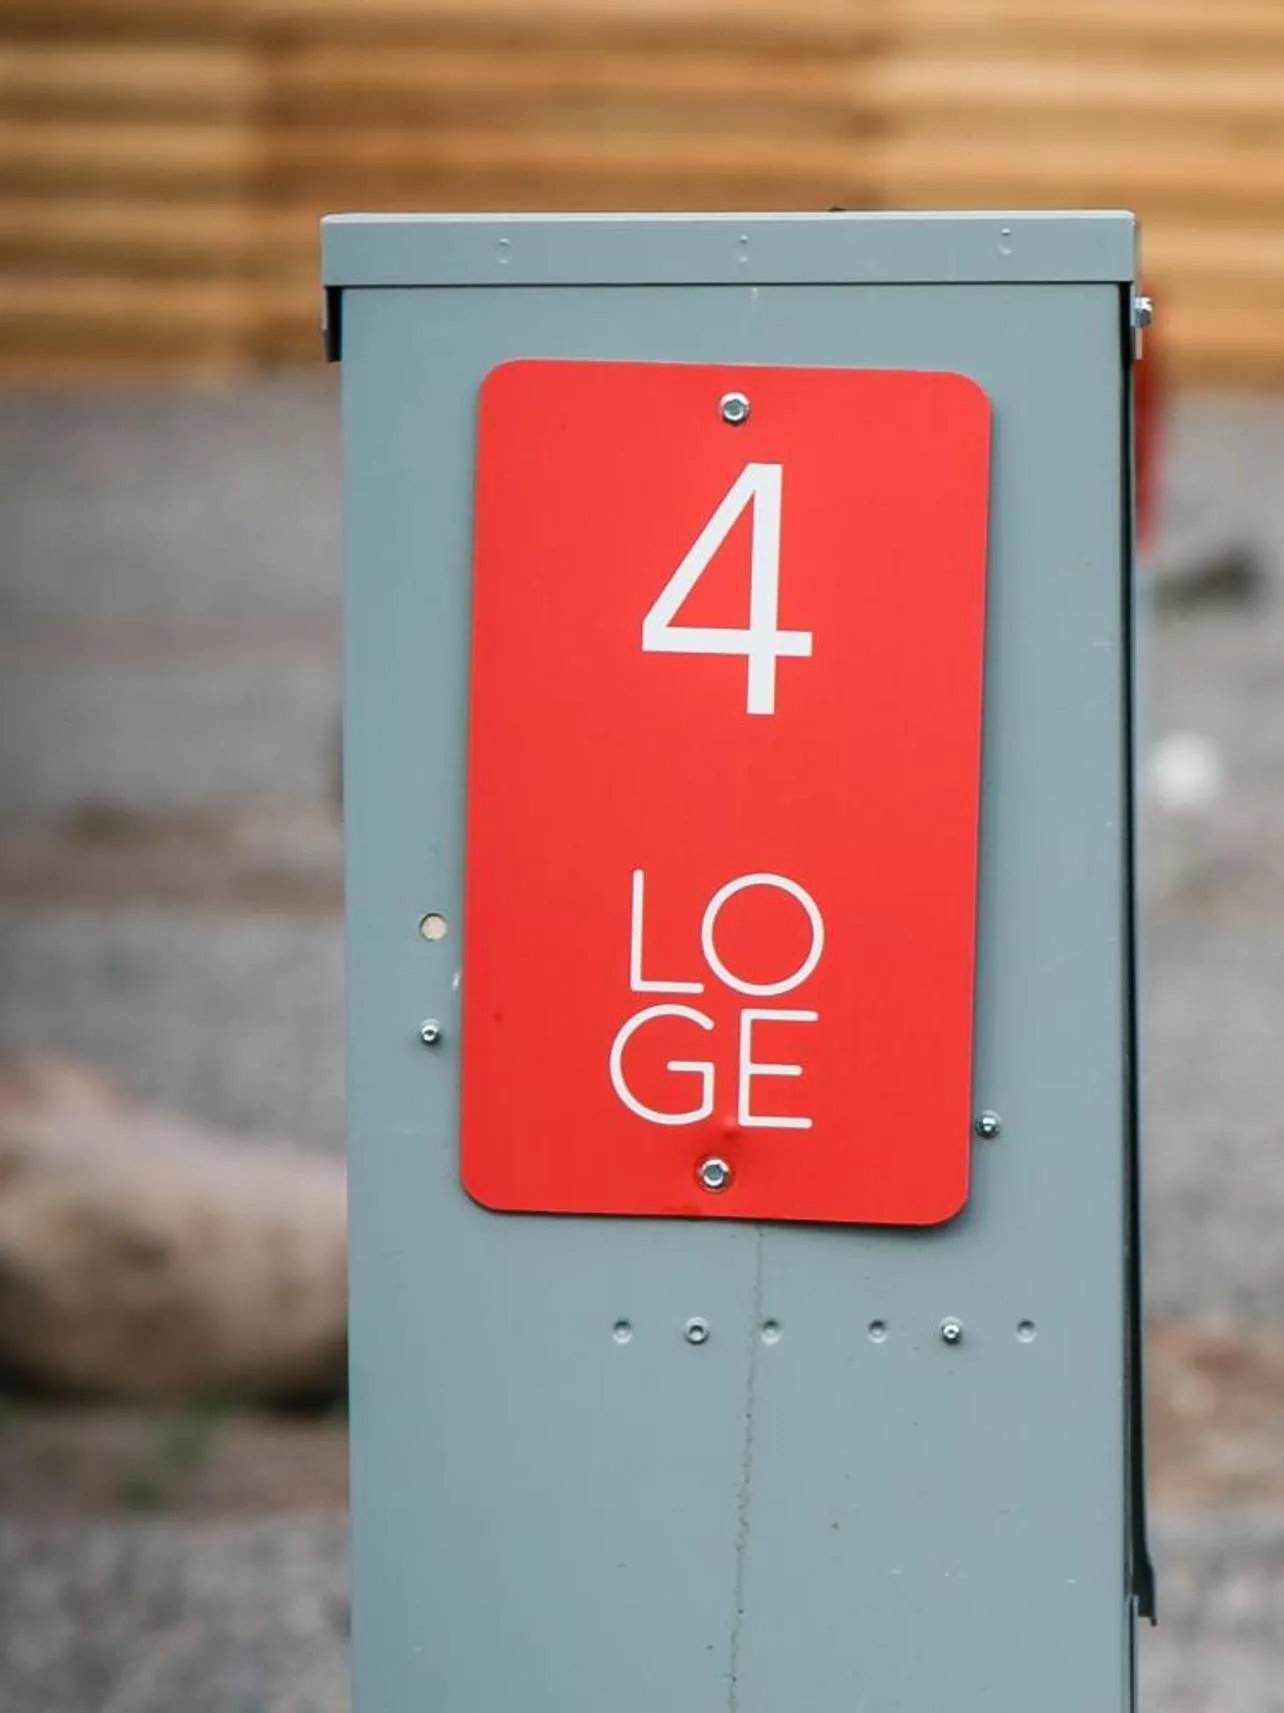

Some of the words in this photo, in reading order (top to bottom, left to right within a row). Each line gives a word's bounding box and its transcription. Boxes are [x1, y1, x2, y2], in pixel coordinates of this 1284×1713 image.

[641, 462, 813, 715] 4
[630, 869, 824, 997] LO
[609, 1004, 819, 1130] GE
